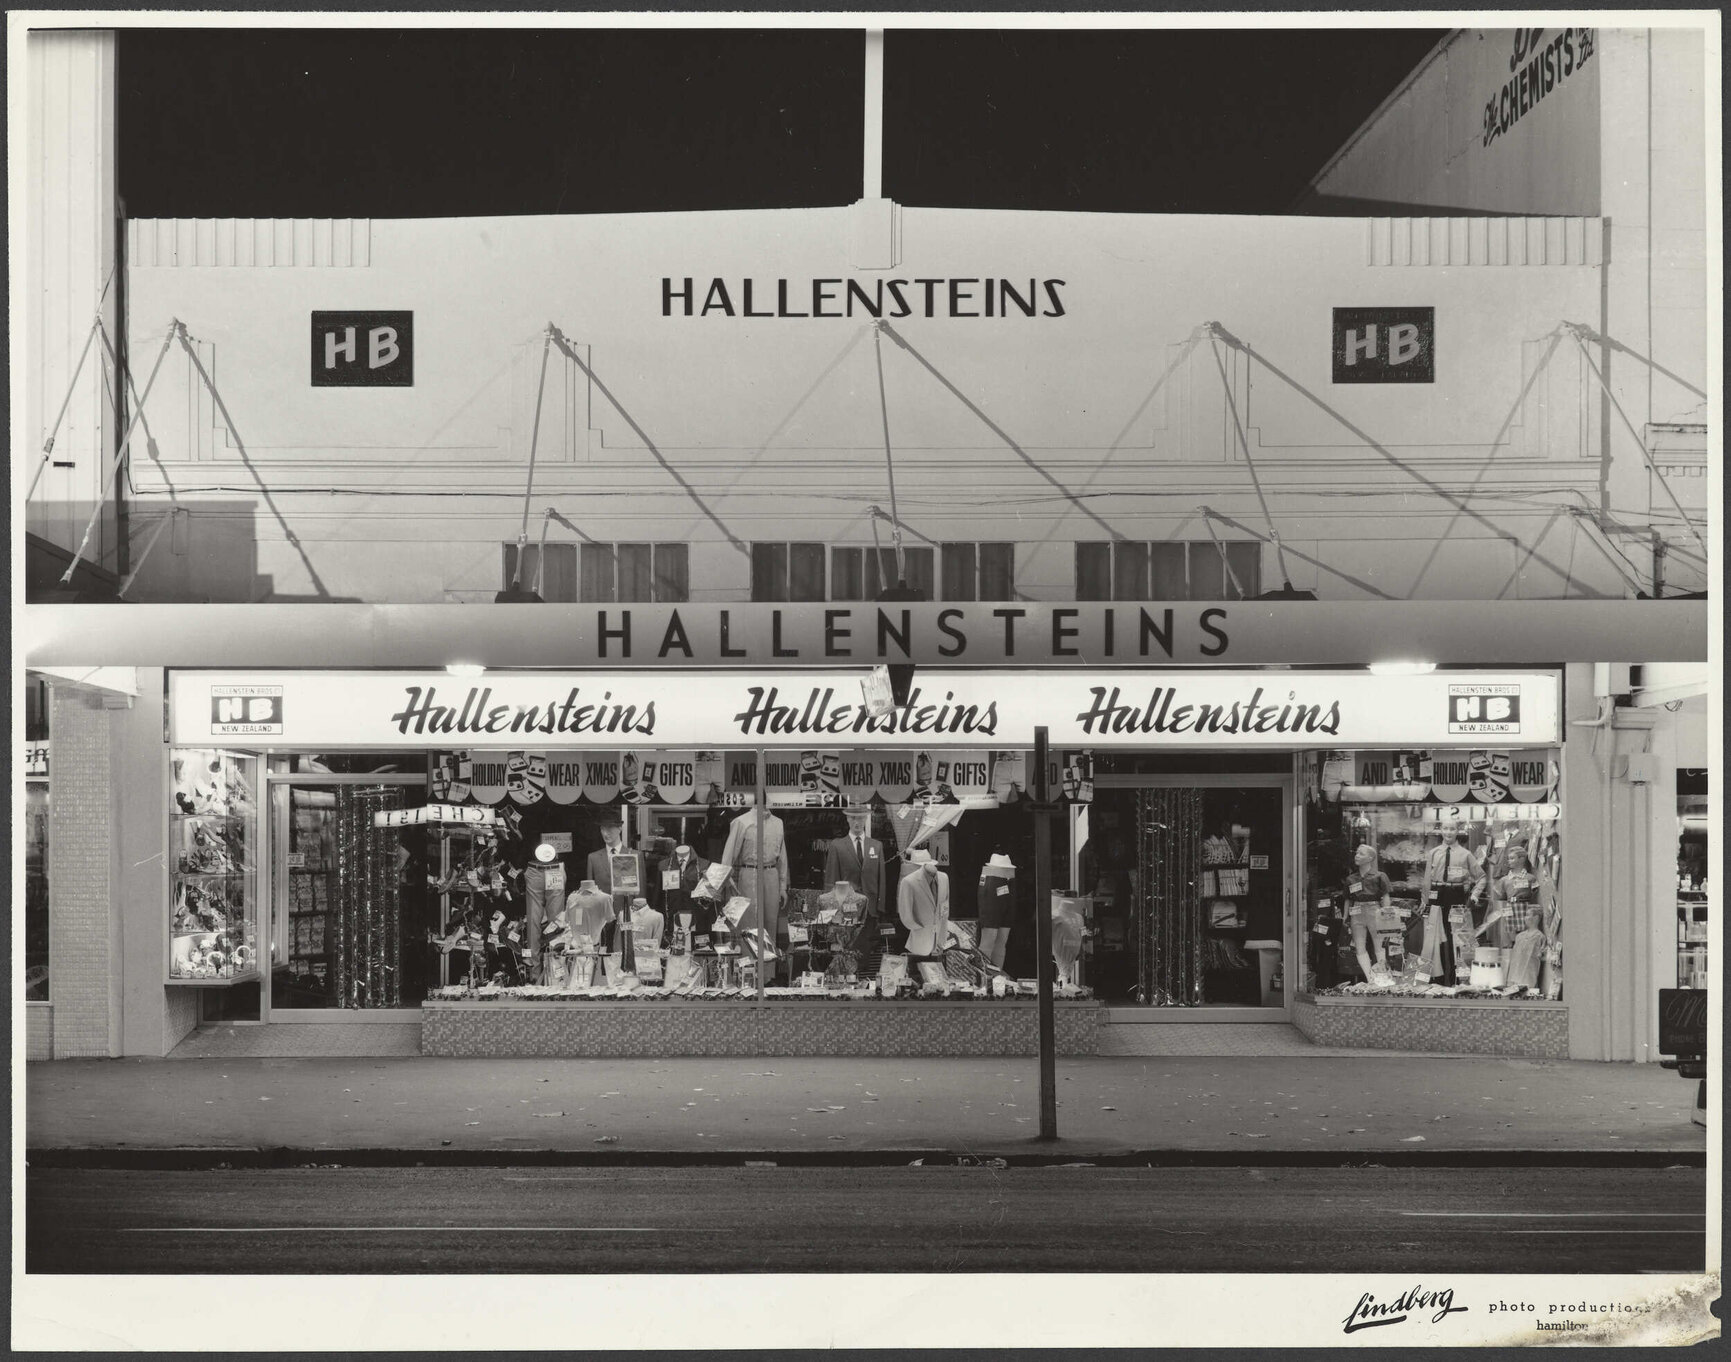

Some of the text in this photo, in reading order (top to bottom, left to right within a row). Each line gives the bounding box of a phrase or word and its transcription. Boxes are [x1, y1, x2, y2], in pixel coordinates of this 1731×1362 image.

[1500, 28, 1574, 134] CHEMISTS
[661, 277, 1066, 318] HALLENSTEINS
[324, 325, 400, 370] HB
[1345, 322, 1421, 366] HB
[598, 607, 1229, 659] HALLENSTEINS
[391, 686, 656, 736] Hallensteins
[1075, 686, 1341, 736] Hallensteins
[1459, 724, 1510, 732] NEW ZEALAND
[471, 761, 987, 787] HOLIDAY WEAR XMAS GIFTS AND HOLIDAY WEAR XMAS GIFTS
[1361, 761, 1545, 786] AND HOLIDAY WEAR
